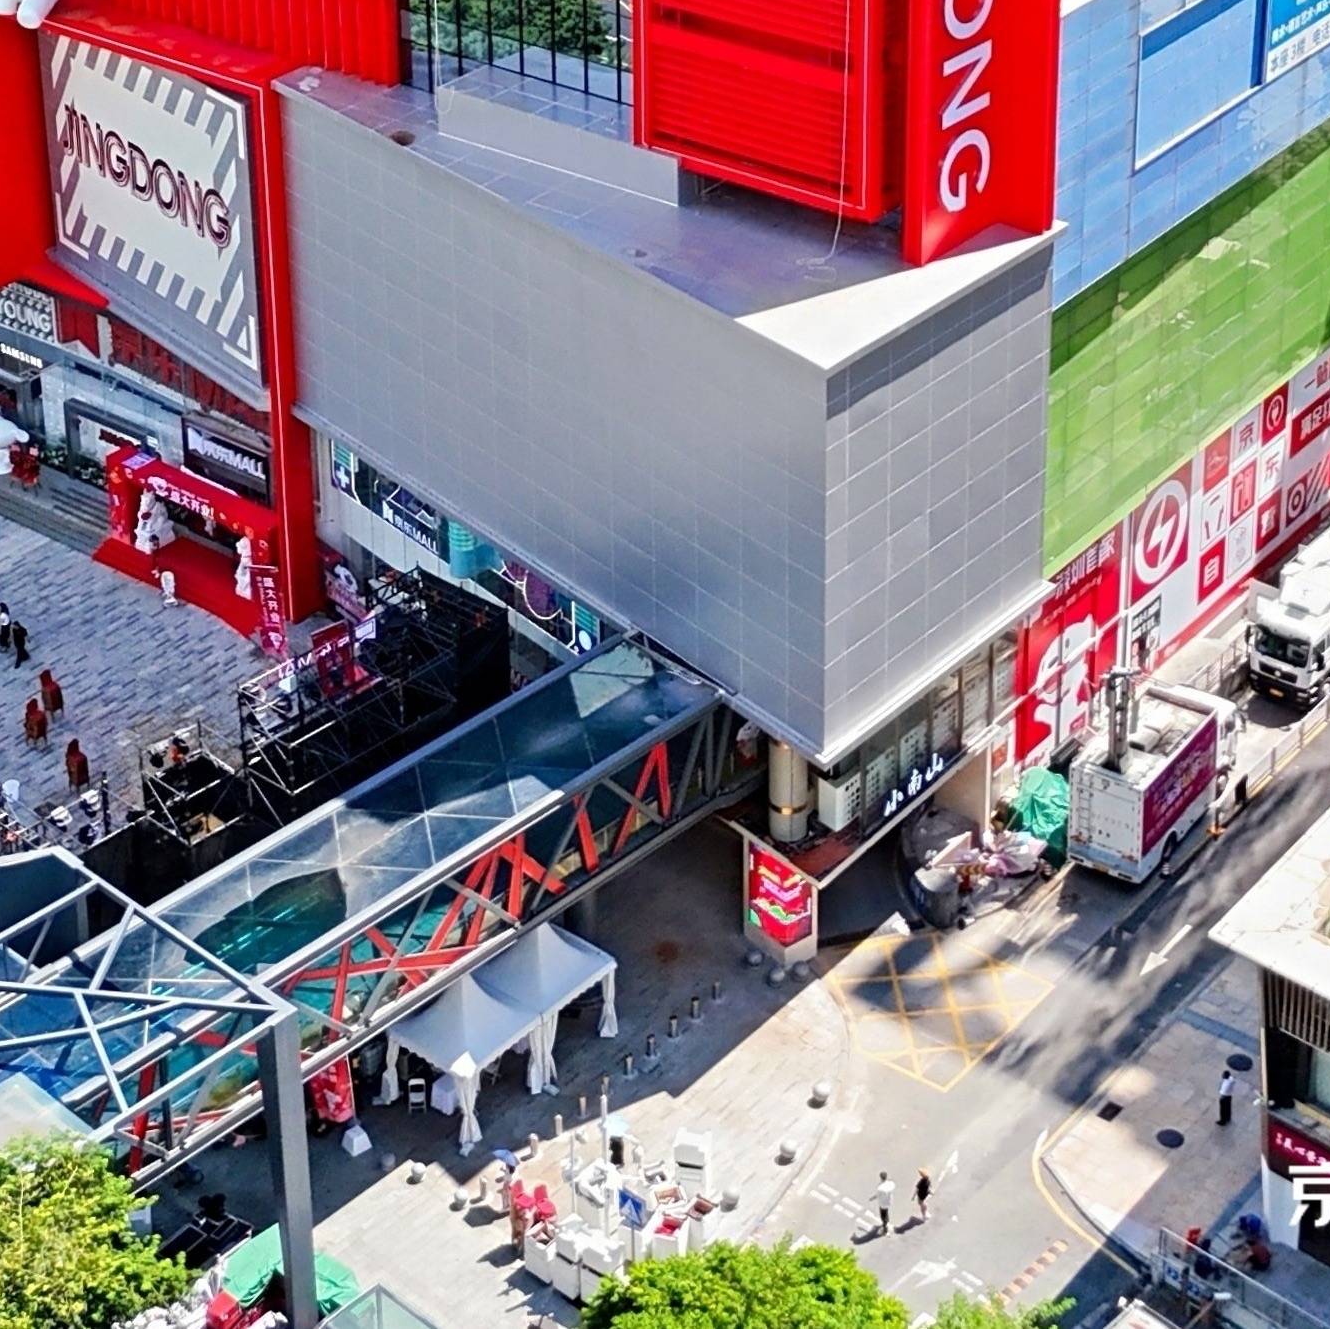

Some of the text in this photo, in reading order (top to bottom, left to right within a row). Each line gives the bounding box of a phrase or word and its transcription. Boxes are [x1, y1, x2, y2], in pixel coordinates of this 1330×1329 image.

[63, 104, 233, 249] JINGDONG
[884, 752, 944, 817] 小南山
